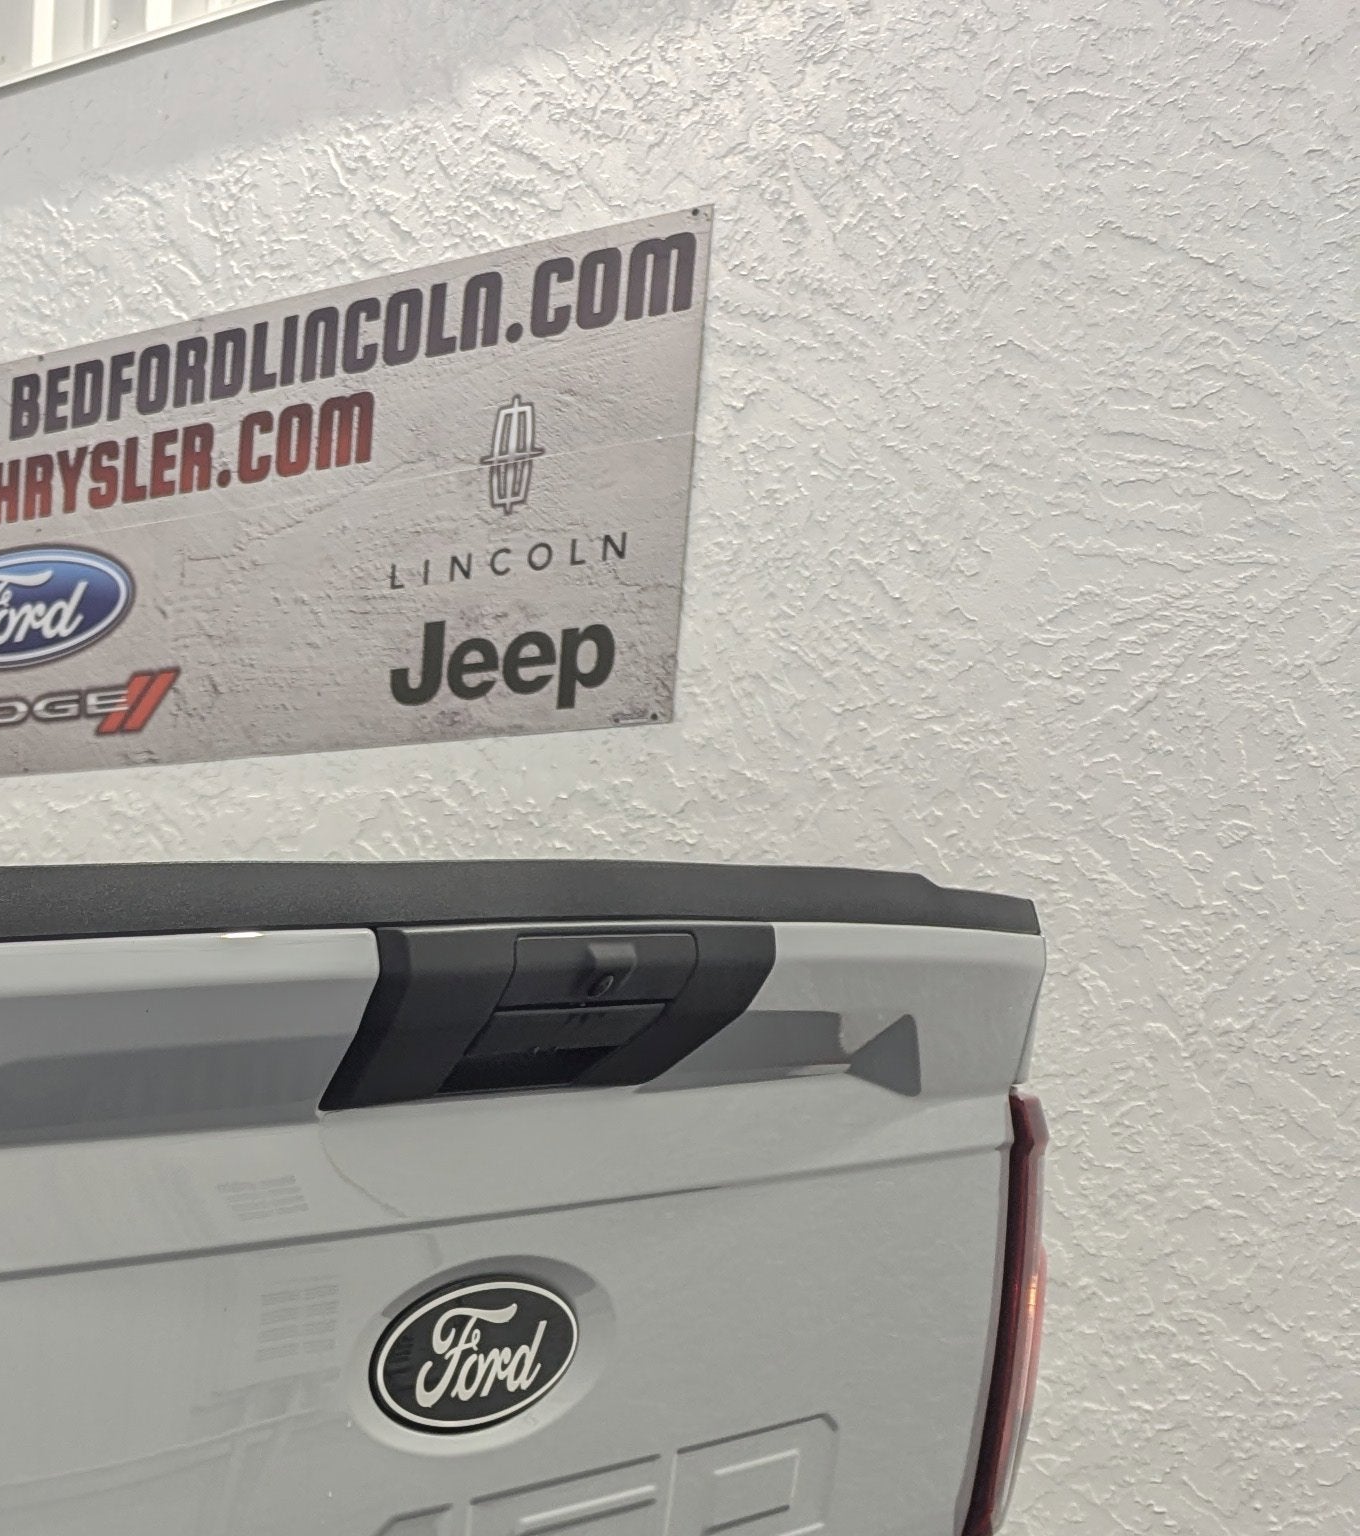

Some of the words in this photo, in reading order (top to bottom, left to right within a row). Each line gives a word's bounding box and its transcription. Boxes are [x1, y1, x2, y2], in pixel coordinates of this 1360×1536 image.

[8, 230, 697, 442] BEDFORDLINCOLN.COM
[390, 531, 629, 590] LINCOLN
[389, 620, 616, 710] Jeep
[416, 1303, 547, 1409] Ford
